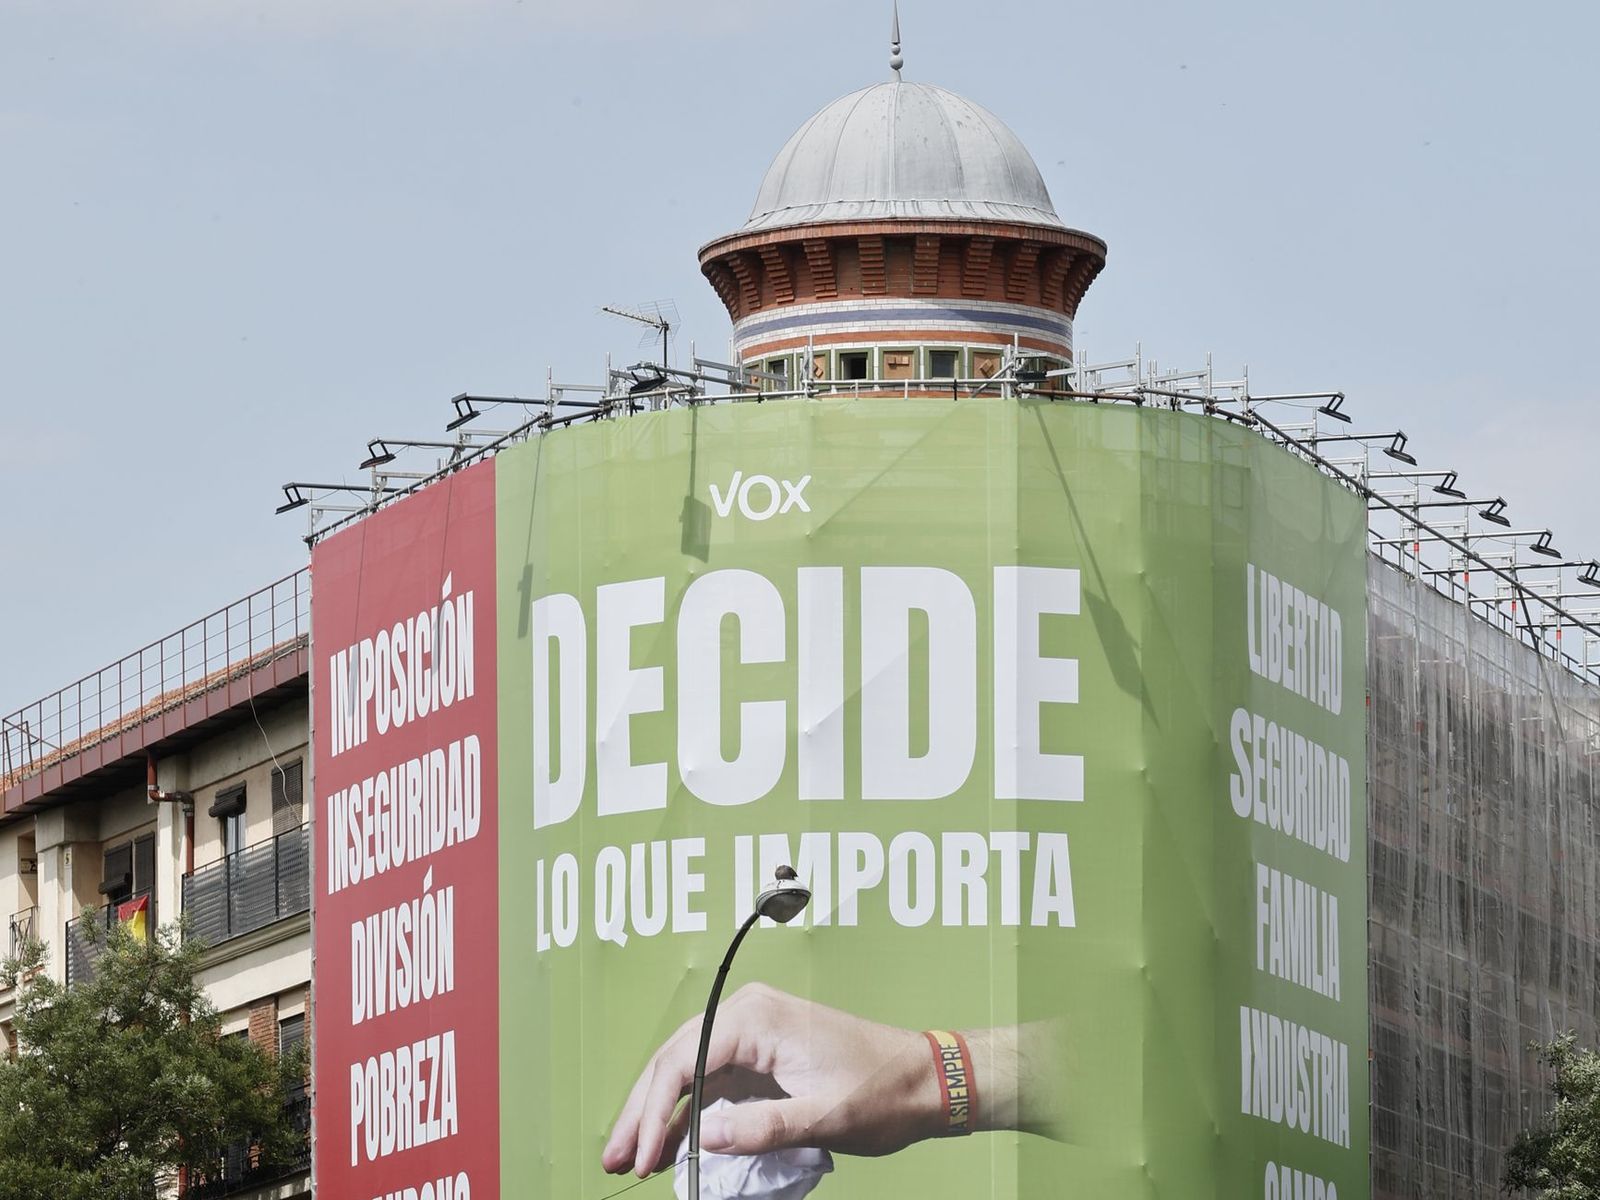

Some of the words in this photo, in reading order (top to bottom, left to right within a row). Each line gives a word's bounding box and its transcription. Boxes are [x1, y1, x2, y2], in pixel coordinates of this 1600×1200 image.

[709, 471, 812, 521] VOX
[330, 571, 474, 757] IMPOSICIÓN
[532, 566, 1085, 830] DECIDE
[1247, 562, 1342, 715] LIBERTAD
[327, 734, 481, 895] INSEGURIDAD
[1230, 707, 1350, 863] SEGURIDAD
[352, 864, 454, 1025] DIVISIÓN
[536, 853, 579, 952] LO
[595, 837, 707, 948] QUE
[735, 831, 1076, 929] IMPORTA
[1257, 862, 1340, 1002] FAMILIA
[350, 1030, 458, 1167] POBREZA
[1240, 1006, 1350, 1149] INDUSTRIA
